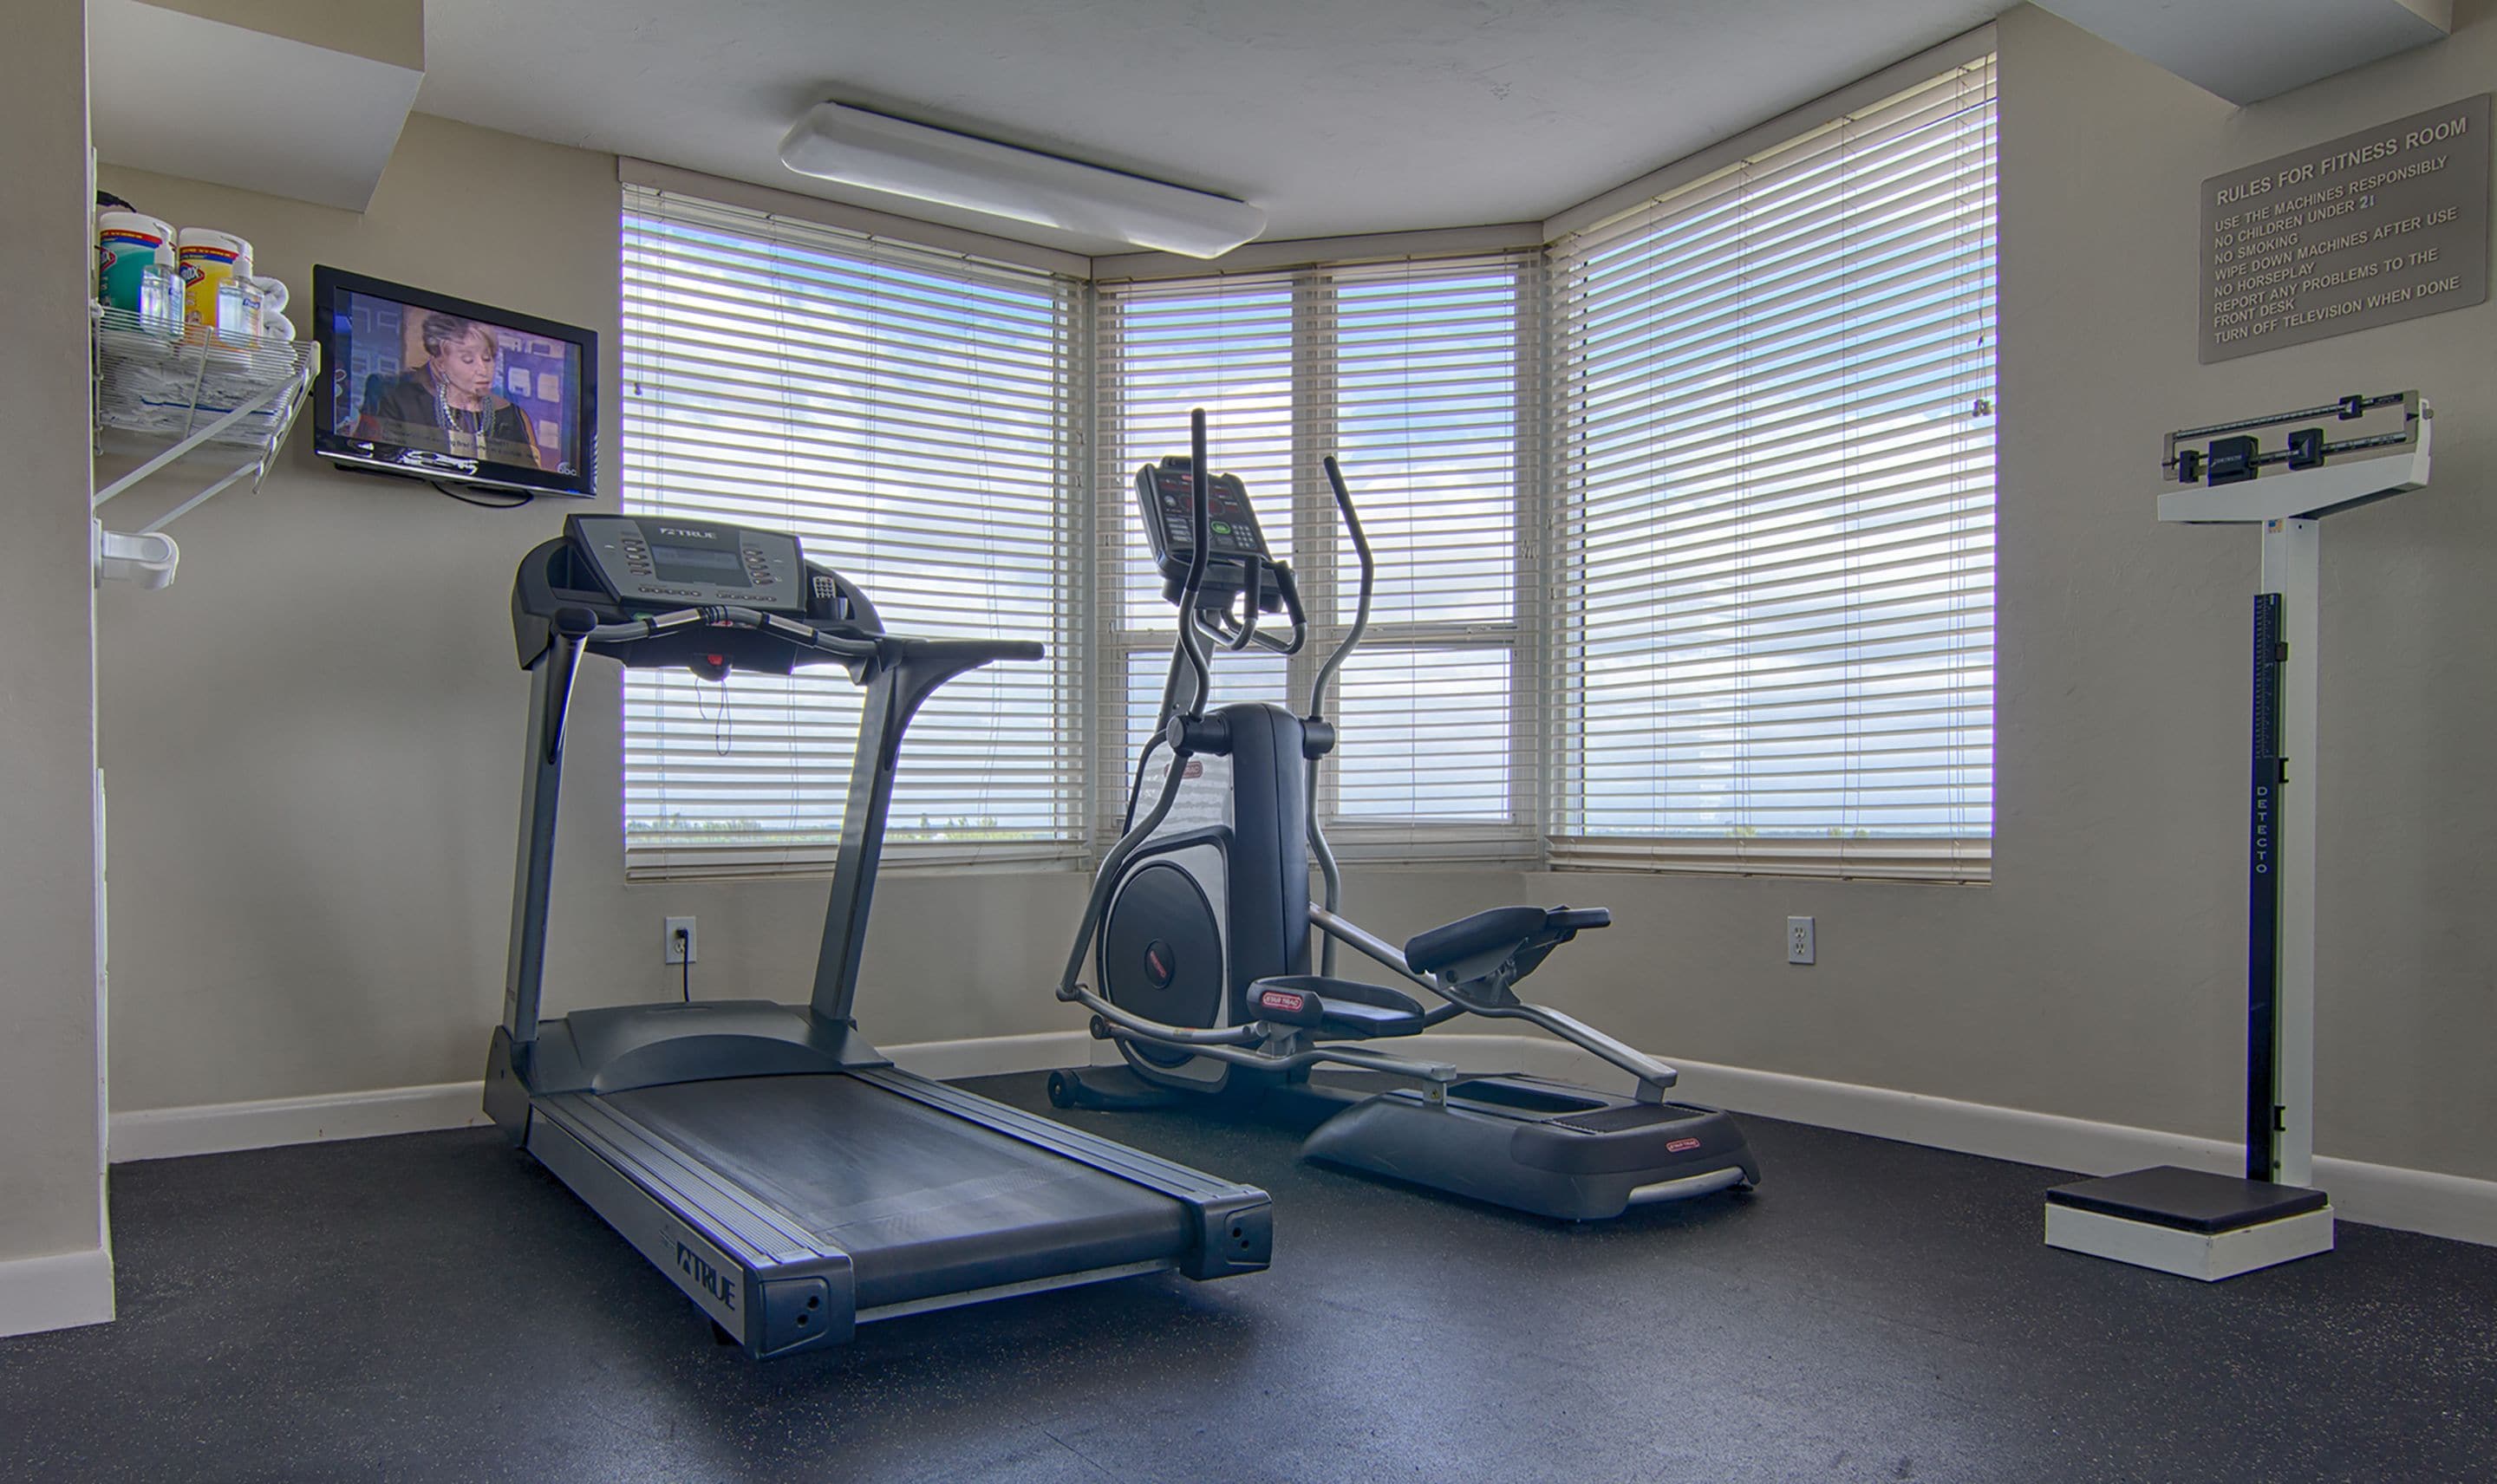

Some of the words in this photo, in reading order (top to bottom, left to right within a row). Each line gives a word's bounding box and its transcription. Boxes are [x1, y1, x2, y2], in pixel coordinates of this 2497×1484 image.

[2217, 176, 2272, 205] RULES
[2279, 164, 2314, 187] FOR
[2321, 139, 2397, 174] FITNESS
[2406, 117, 2467, 149] ROOM
[2215, 215, 2240, 232] USE
[2245, 206, 2270, 224] THE
[2274, 186, 2344, 215] MACHINES
[2349, 155, 2447, 194] RESPONSIBLY
[2214, 234, 2233, 249] NO
[2238, 214, 2303, 242] CHILDREN
[2308, 199, 2355, 223] UNDER
[2359, 195, 2375, 209] 21
[2214, 251, 2233, 265] NO
[2238, 232, 2298, 258] SMOKING
[2215, 264, 2246, 281] WIPE
[2252, 251, 2292, 272] DOWN
[2298, 231, 2368, 260] MACHINES
[2373, 217, 2422, 240] AFTER
[2427, 206, 2457, 225] USE
[2214, 283, 2233, 298] NO
[2238, 262, 2315, 292] HORSEPLAY
[2214, 291, 2266, 314] REPORT
[2270, 283, 2298, 300] ANY
[2303, 263, 2378, 292] PROBLEMS
[2383, 257, 2403, 272] TO
[2409, 248, 2438, 265] THE
[2213, 308, 2256, 328] FRONT
[2260, 298, 2295, 317] DESK
[2214, 326, 2248, 344] TURN
[2253, 319, 2279, 335] OFF
[2284, 299, 2363, 328] TELEVISION
[2367, 288, 2411, 308] WHEN
[2417, 276, 2461, 297] DONE
[558, 463, 577, 476] abc
[676, 529, 717, 539] TRUE
[2256, 786, 2267, 873] DETECTO
[1282, 998, 1299, 1007] TRAC
[692, 1253, 735, 1312] TRUE
